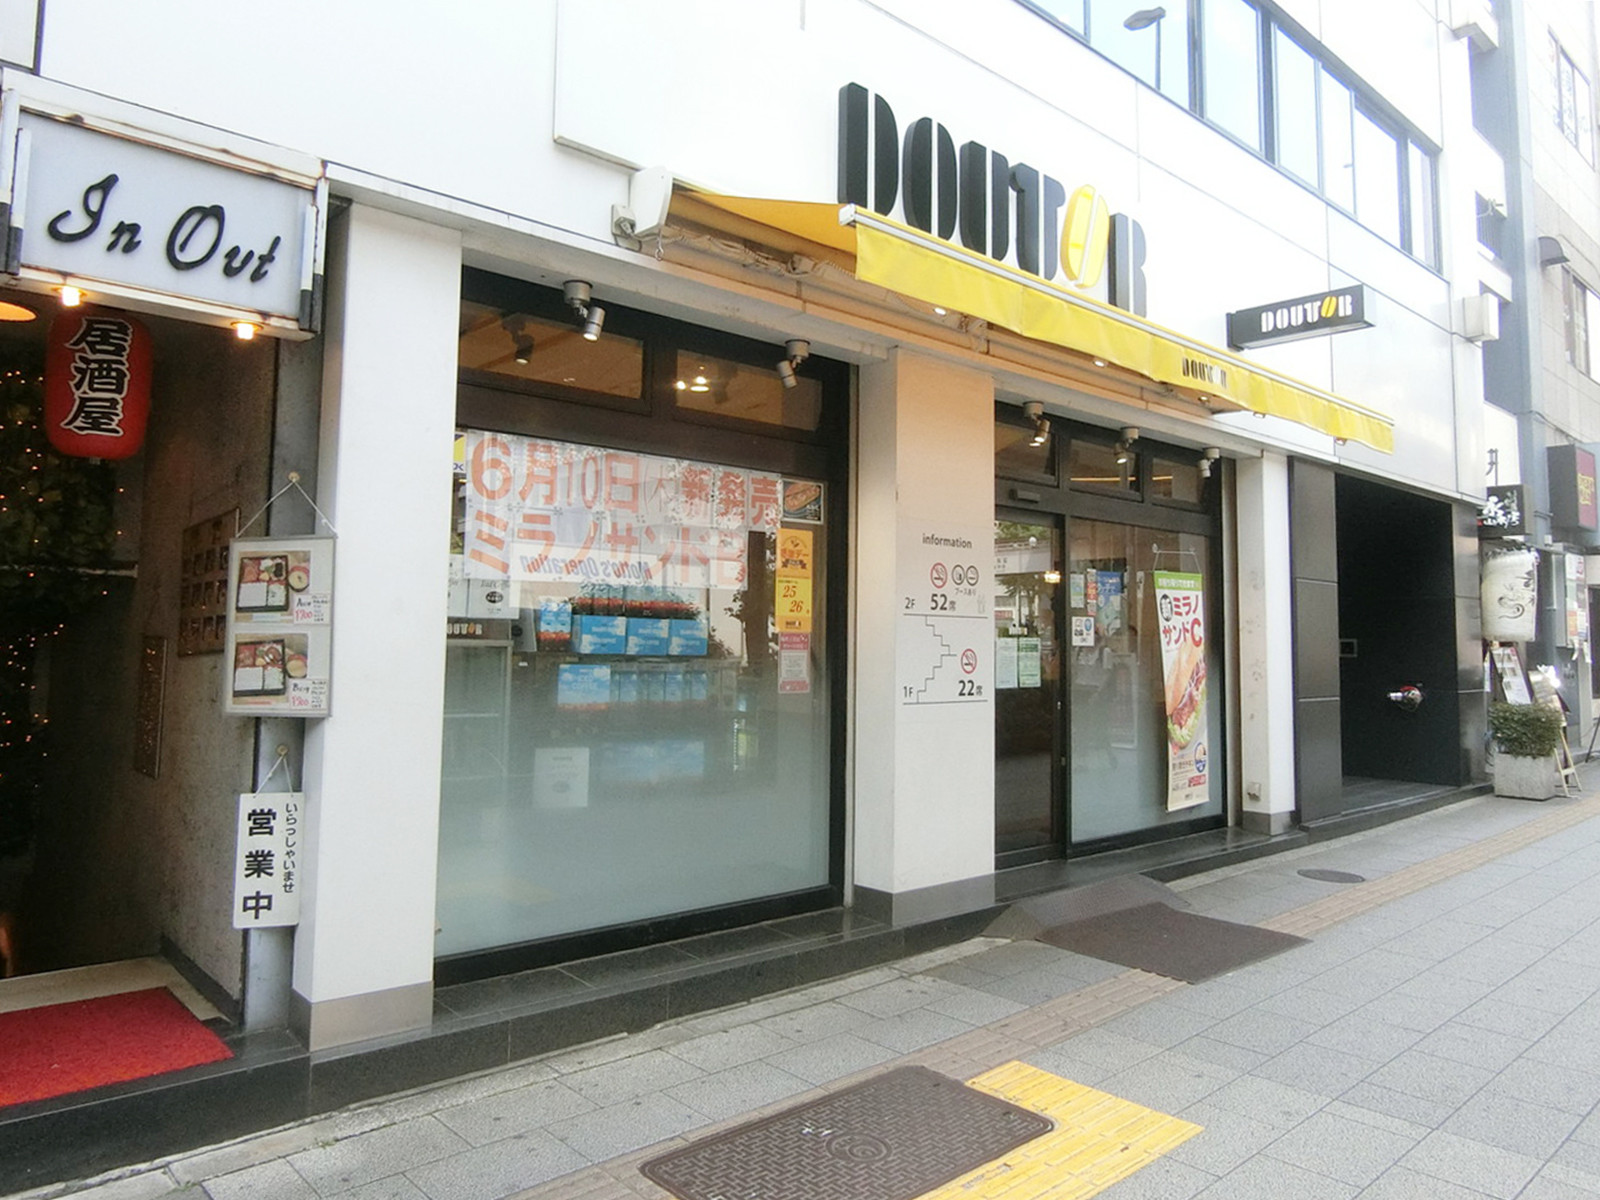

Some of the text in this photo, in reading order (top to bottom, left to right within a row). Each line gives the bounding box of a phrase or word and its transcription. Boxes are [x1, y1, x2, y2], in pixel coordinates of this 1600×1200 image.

[838, 82, 1147, 318] DOUTOR
[47, 174, 281, 282] In Out
[1260, 294, 1353, 333] DOUTOR
[61, 315, 134, 438] 居酒屋
[922, 533, 972, 549] information
[783, 585, 797, 598] 25
[789, 600, 804, 613] 26
[905, 597, 915, 610] 2F
[1173, 594, 1199, 617] ミラノ
[447, 622, 483, 635] OUTOR
[1162, 617, 1203, 648] サンドC
[282, 802, 298, 894] いらっしゃいませ
[242, 808, 277, 920] 営業中
